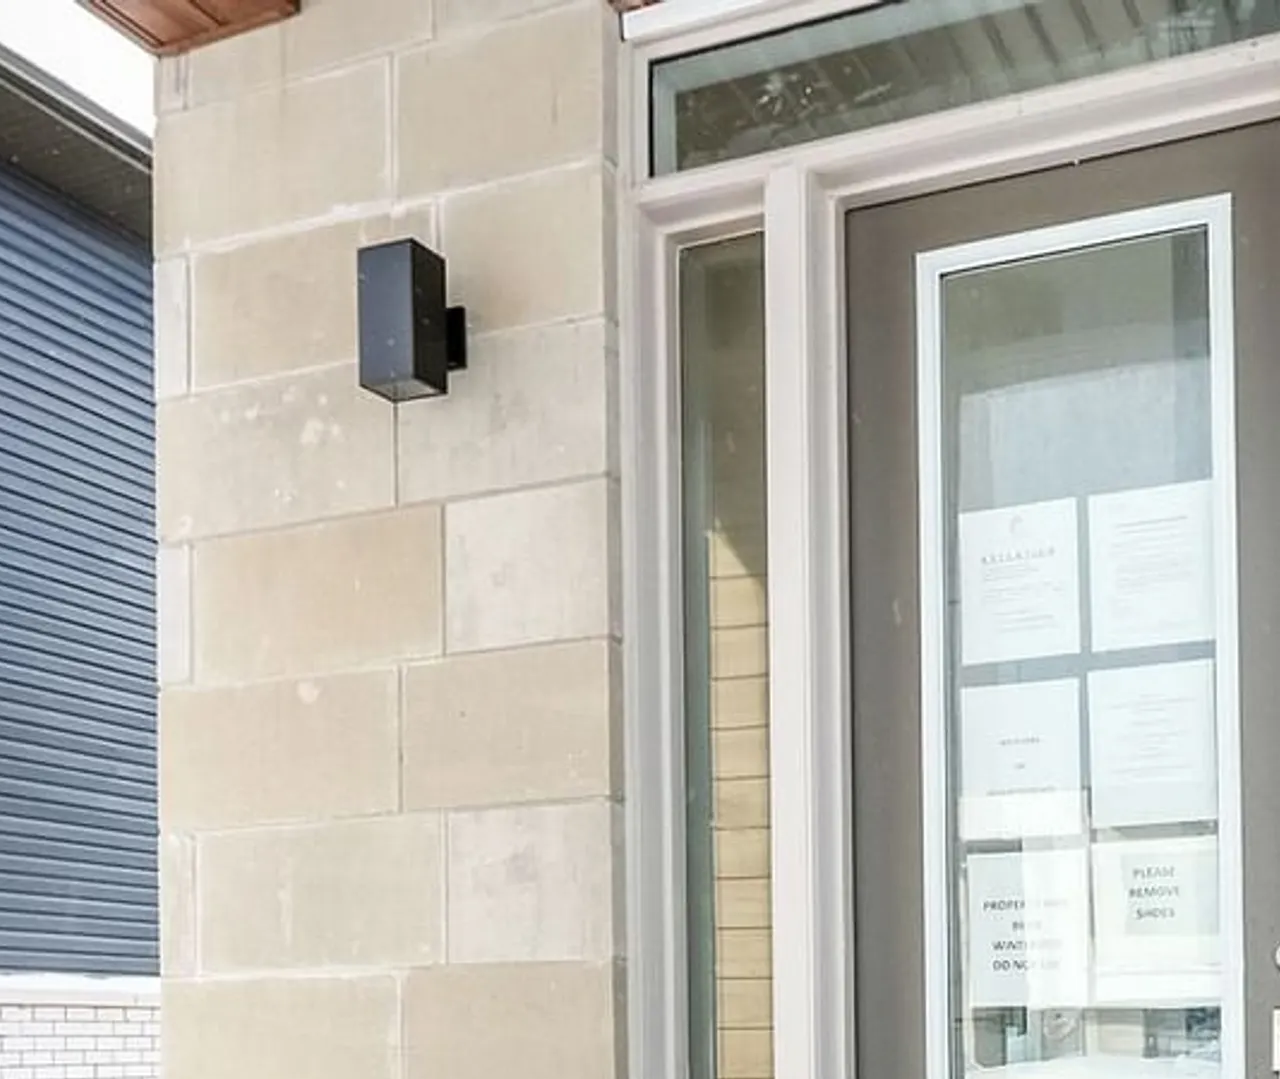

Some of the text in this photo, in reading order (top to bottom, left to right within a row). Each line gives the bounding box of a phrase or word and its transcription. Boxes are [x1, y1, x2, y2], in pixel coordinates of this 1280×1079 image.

[1132, 866, 1176, 880] PLEASE
[1128, 885, 1181, 899] REMOVE
[1136, 906, 1176, 920] SHOES
[992, 959, 1011, 972] DO
